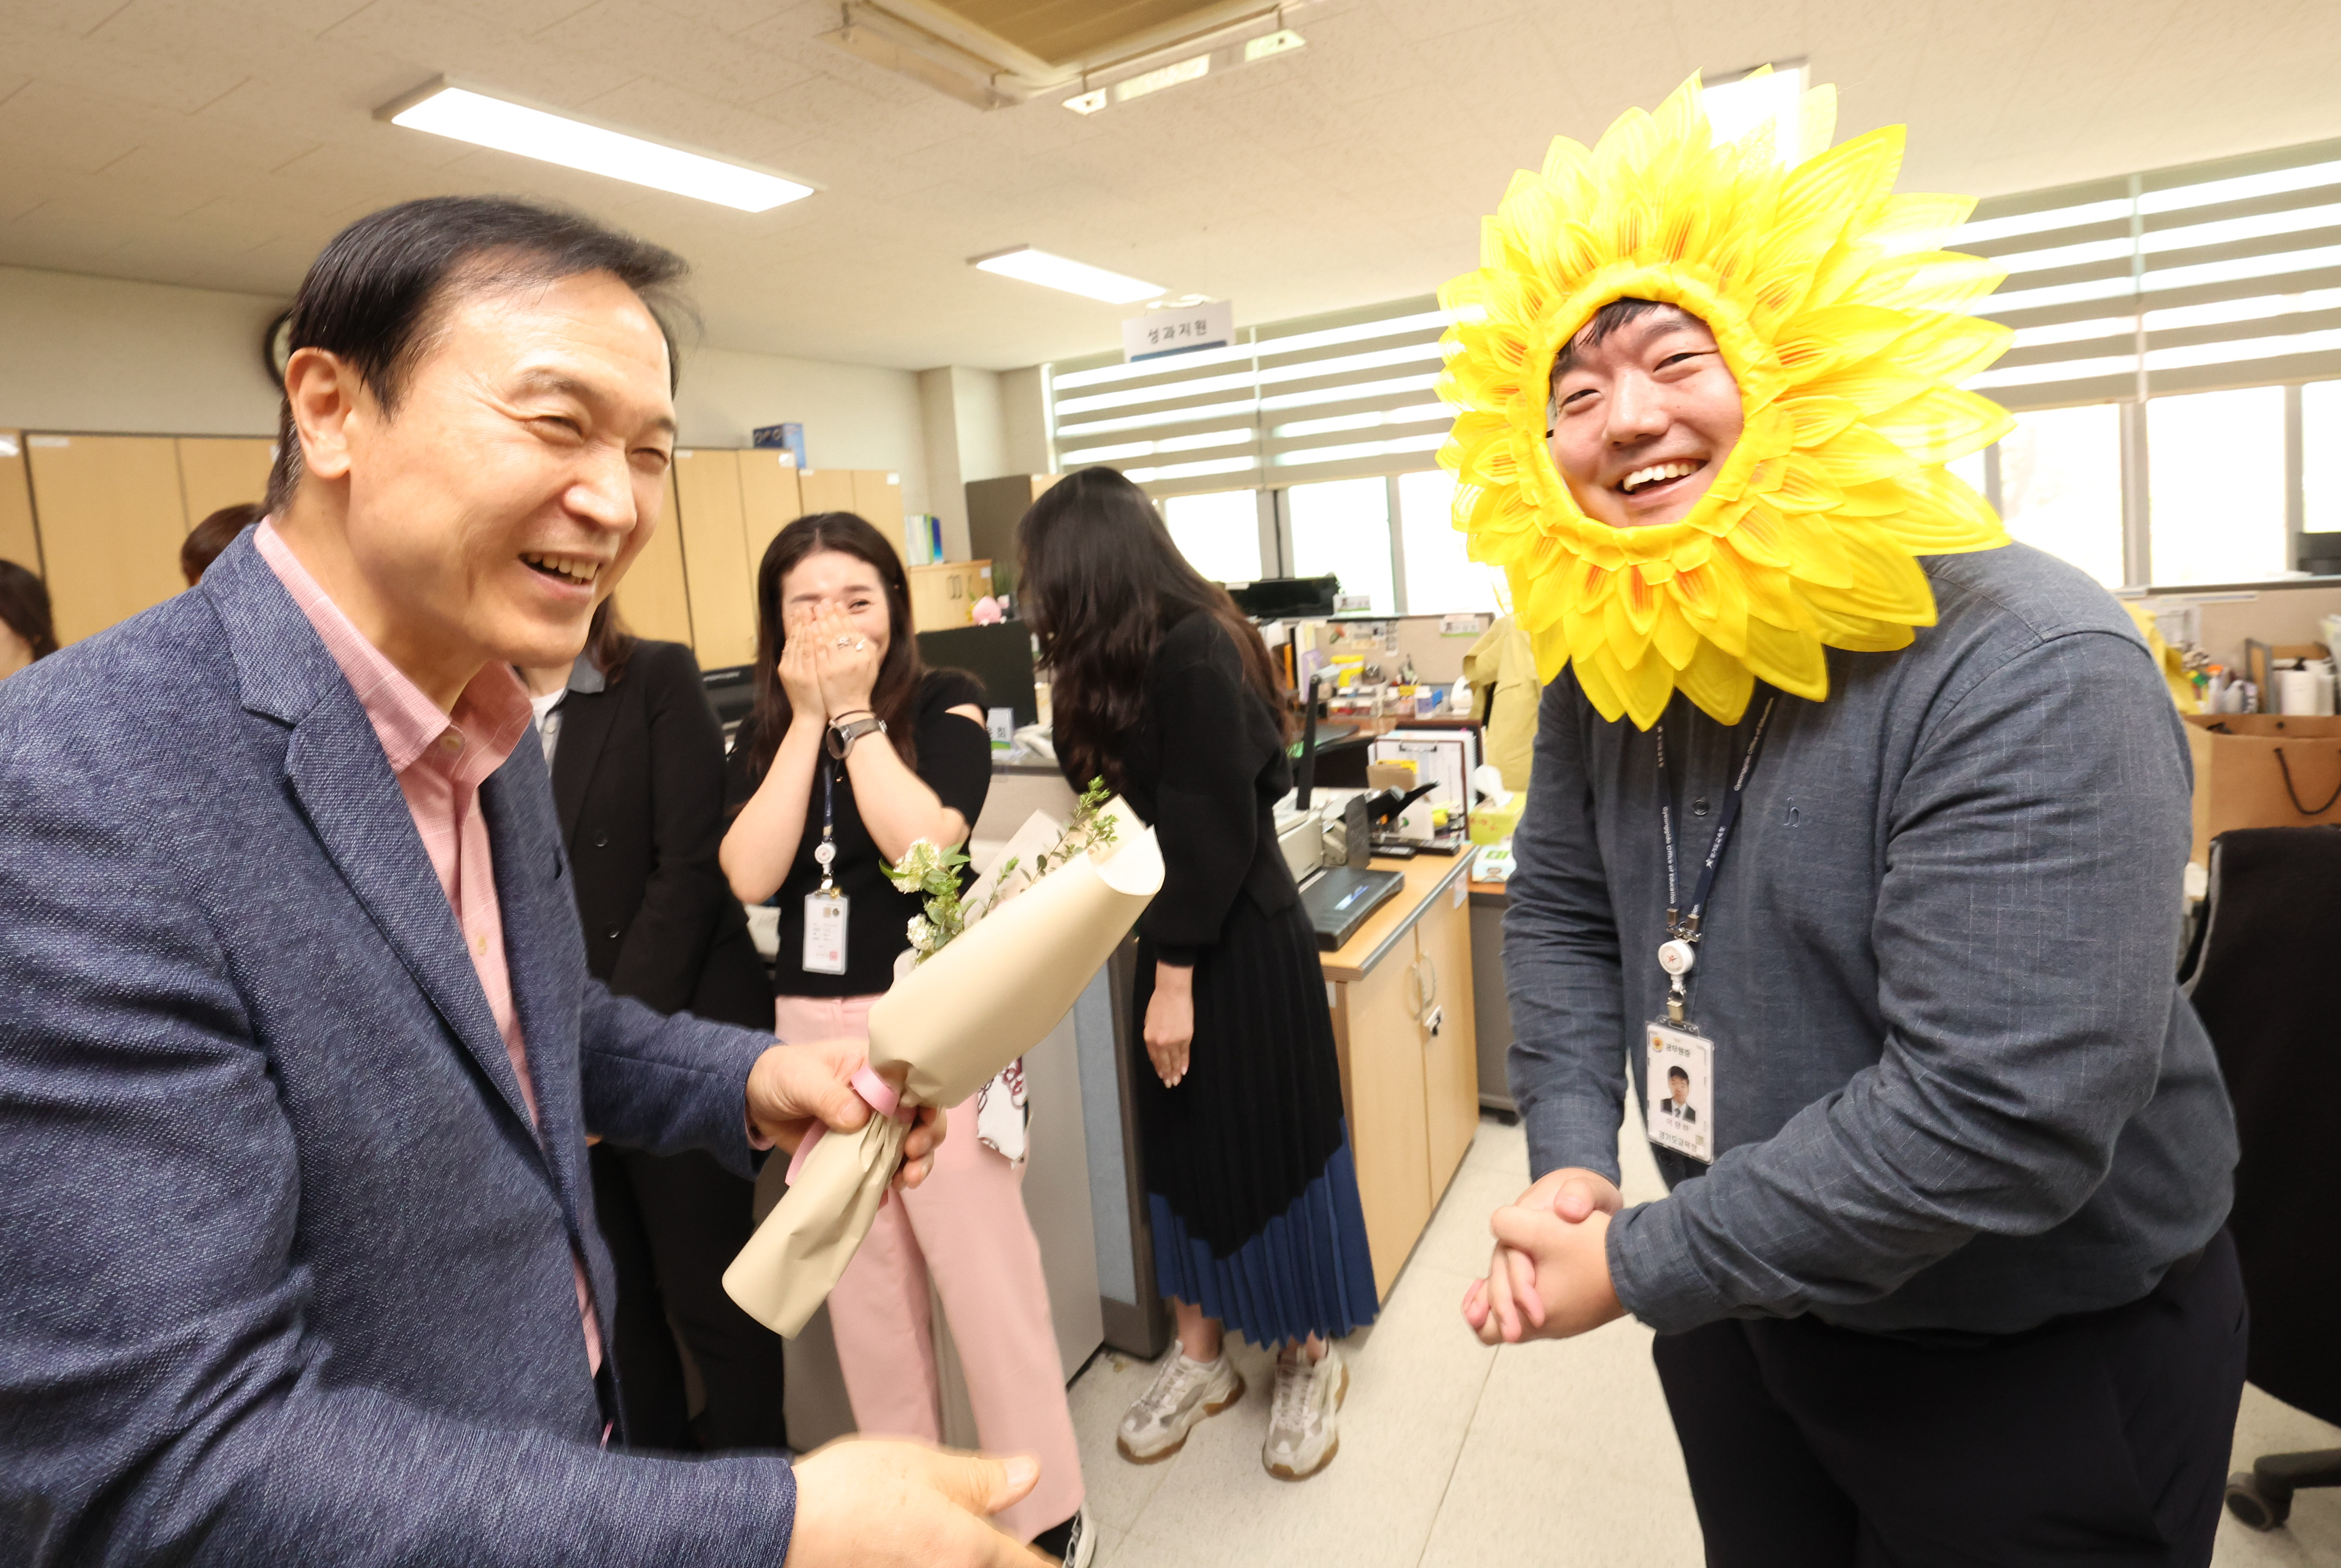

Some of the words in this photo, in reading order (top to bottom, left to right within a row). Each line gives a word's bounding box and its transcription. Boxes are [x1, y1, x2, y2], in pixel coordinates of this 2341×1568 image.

[1148, 319, 1207, 345] 성과지원
[1662, 806, 1670, 844] Gyeonggido
[1666, 1043, 1690, 1057] 공무원증
[1659, 1130, 1697, 1152] 경기도교육청
